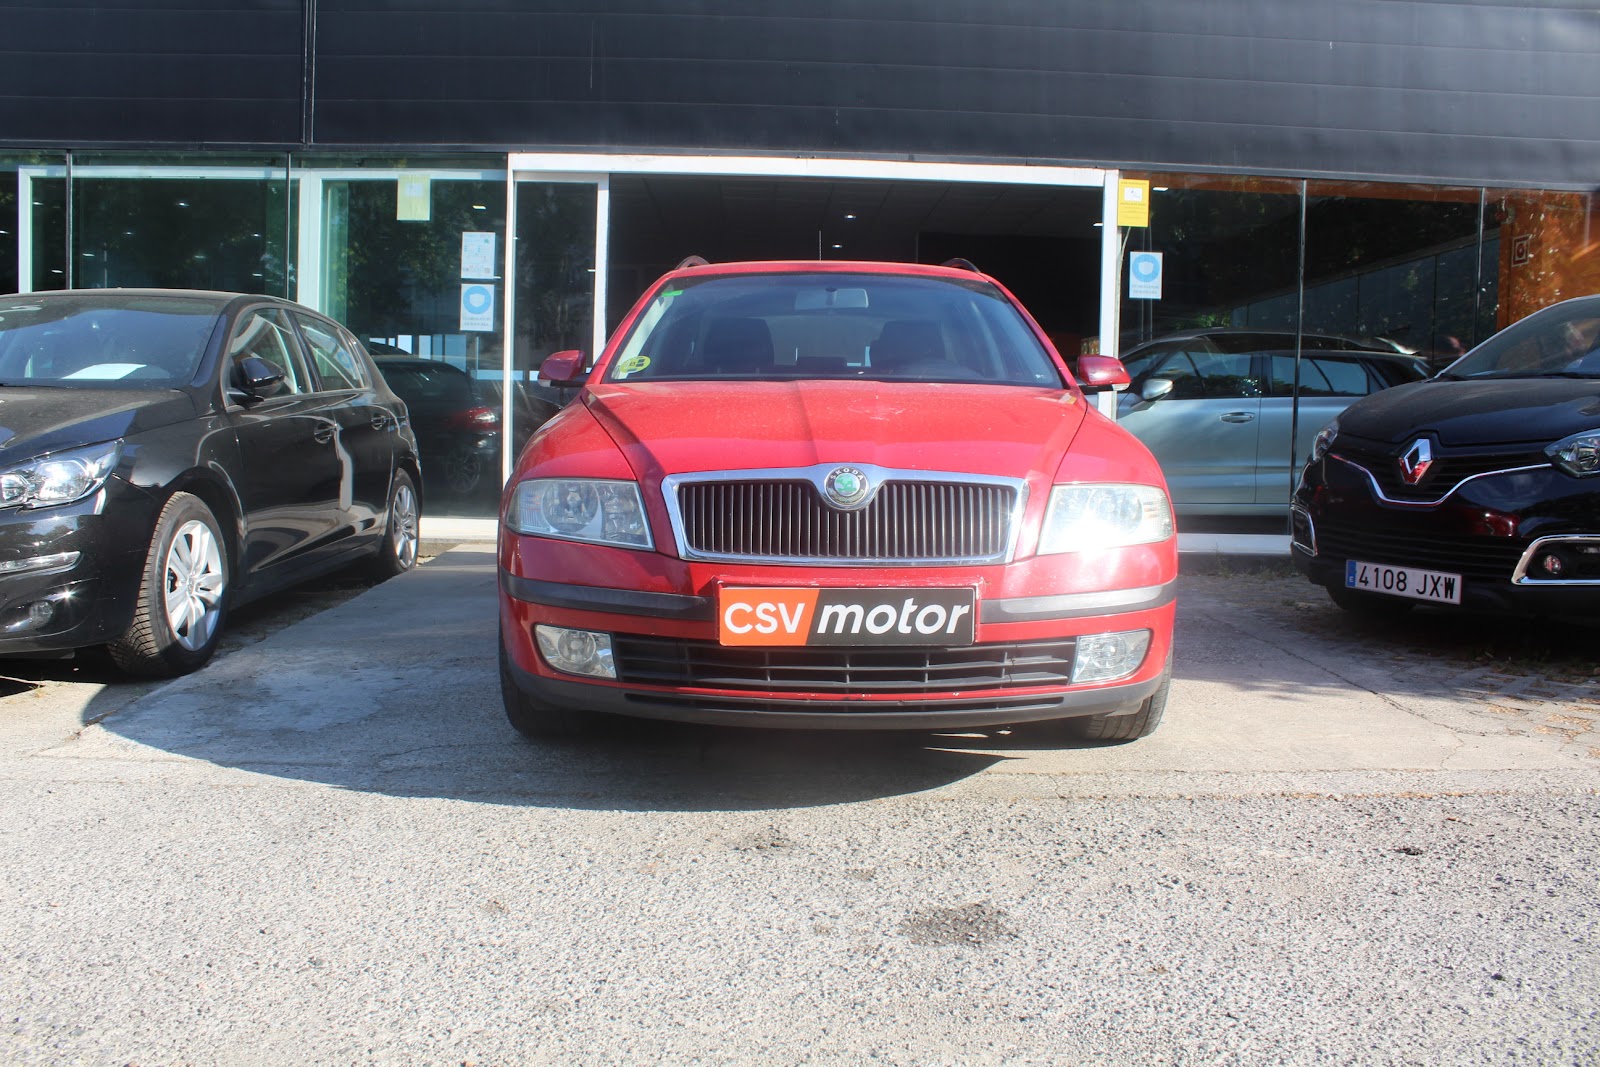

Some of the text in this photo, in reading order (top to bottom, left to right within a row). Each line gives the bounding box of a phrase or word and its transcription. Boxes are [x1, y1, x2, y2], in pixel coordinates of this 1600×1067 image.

[1358, 565, 1456, 600] 4108 JXW
[724, 597, 971, 635] CSV motor
